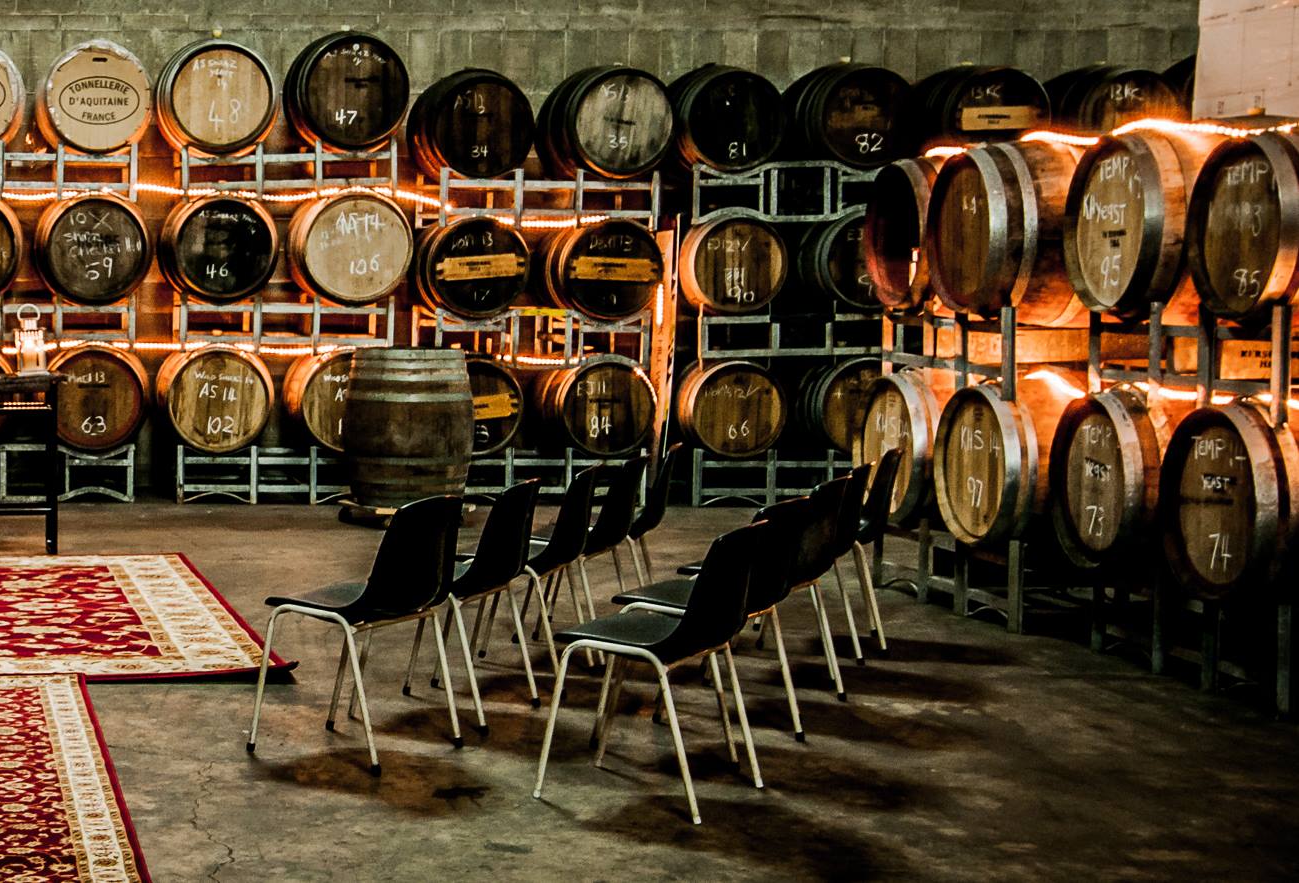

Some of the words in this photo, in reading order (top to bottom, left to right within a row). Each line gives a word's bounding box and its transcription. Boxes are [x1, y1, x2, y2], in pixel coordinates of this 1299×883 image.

[68, 79, 131, 95] TONNELLERIE
[68, 96, 130, 107] D'AQUITAINE
[81, 111, 116, 122] FRANCE
[208, 99, 242, 132] 48
[335, 108, 358, 126] 47
[470, 145, 489, 159] 34
[608, 134, 628, 149] 35
[728, 141, 747, 160] 81
[855, 132, 884, 154] 82
[1224, 160, 1270, 186] TEMP
[69, 212, 87, 226] 10
[85, 256, 113, 280] 59
[205, 261, 229, 279] 46
[348, 253, 381, 276] 106
[1100, 254, 1122, 289] 95
[726, 285, 755, 303] 90
[857, 273, 874, 297] 9
[1233, 267, 1262, 299] 85
[198, 383, 218, 399] AS
[81, 415, 107, 436] 63
[206, 415, 235, 435] 102
[589, 415, 613, 438] 84
[728, 418, 750, 441] 66
[961, 424, 984, 452] KHS
[1190, 435, 1227, 461] TEMP
[966, 476, 983, 508] 97
[1085, 504, 1105, 537] 73
[1208, 533, 1233, 573] 74
